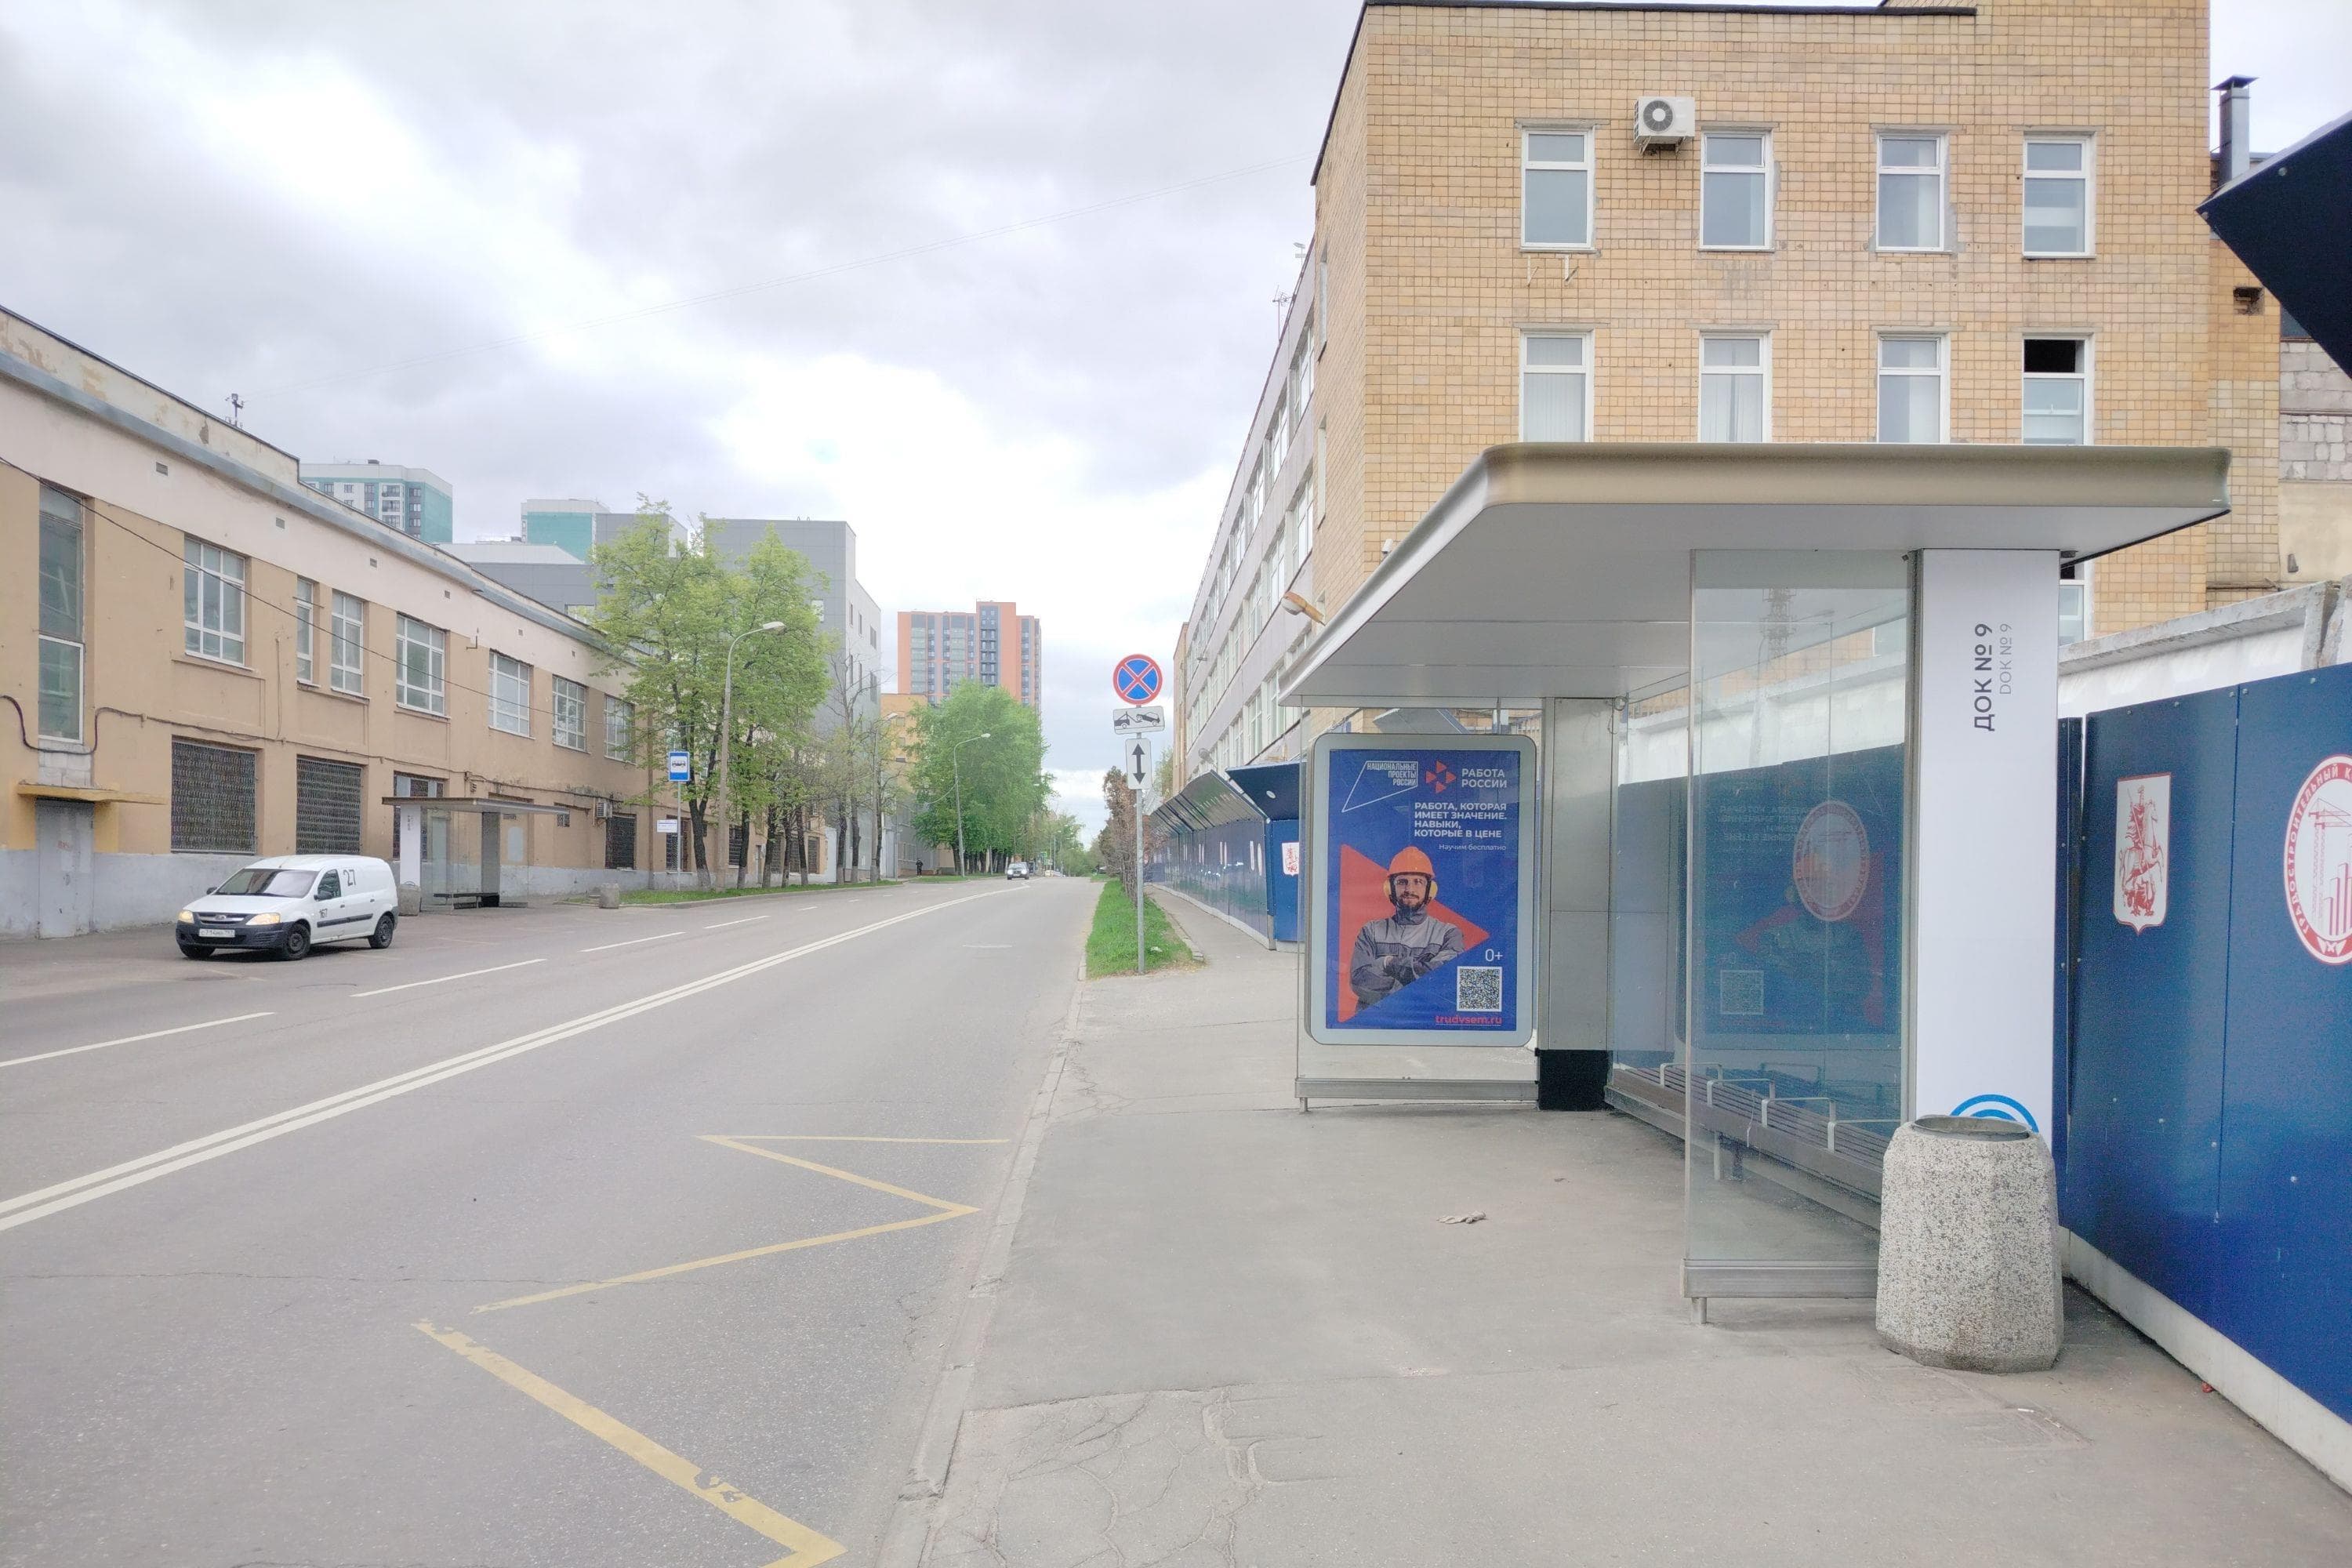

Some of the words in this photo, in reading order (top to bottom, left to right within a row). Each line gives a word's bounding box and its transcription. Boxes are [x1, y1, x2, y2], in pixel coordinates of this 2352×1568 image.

[1974, 623, 1992, 637] 9
[1999, 623, 2012, 632] 9
[1999, 660, 2012, 694] DOK
[1974, 678, 1994, 731] ДОК
[1388, 770, 1417, 779] ПРОЕКТЫ
[1461, 768, 1505, 778] РАБОТА
[1461, 779, 1508, 788] РОССИИ
[1414, 802, 1457, 811] РАБОТА,
[1414, 821, 1461, 829] НАВЫКИ,
[1475, 830, 1502, 839] ЦЕНЕ
[343, 869, 357, 887] 27
[1485, 949, 1503, 962] 0+
[1436, 1015, 1502, 1025] trudvsem.ru
